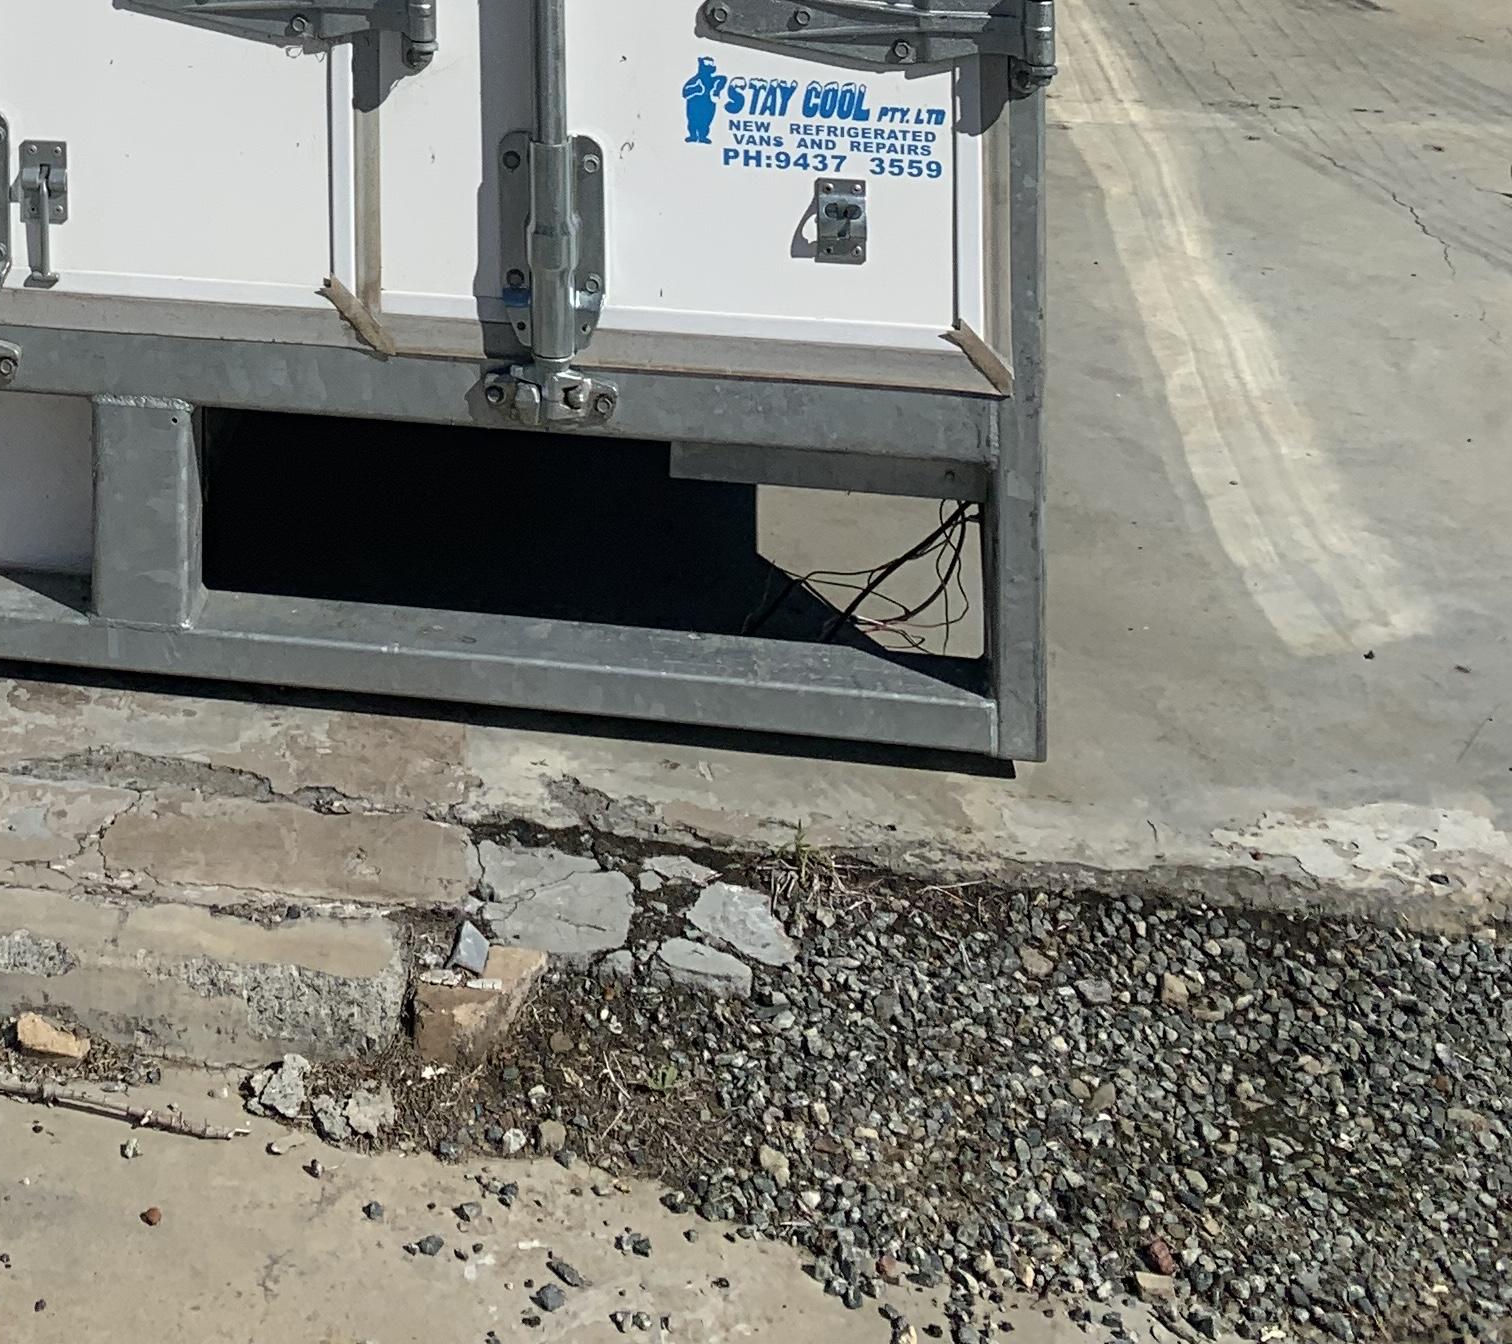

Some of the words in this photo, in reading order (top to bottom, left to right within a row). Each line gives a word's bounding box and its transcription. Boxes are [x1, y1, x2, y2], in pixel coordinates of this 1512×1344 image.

[724, 76, 798, 117] STAY
[802, 80, 870, 122] COOL
[913, 108, 946, 126] LTD
[728, 119, 770, 133] NEW
[789, 122, 936, 143] REFRIGERATED
[732, 133, 784, 148] VANS
[796, 137, 837, 151] AND
[850, 140, 932, 156] REPAIRS
[722, 147, 847, 173] PH:9437
[869, 156, 943, 179] 3559
